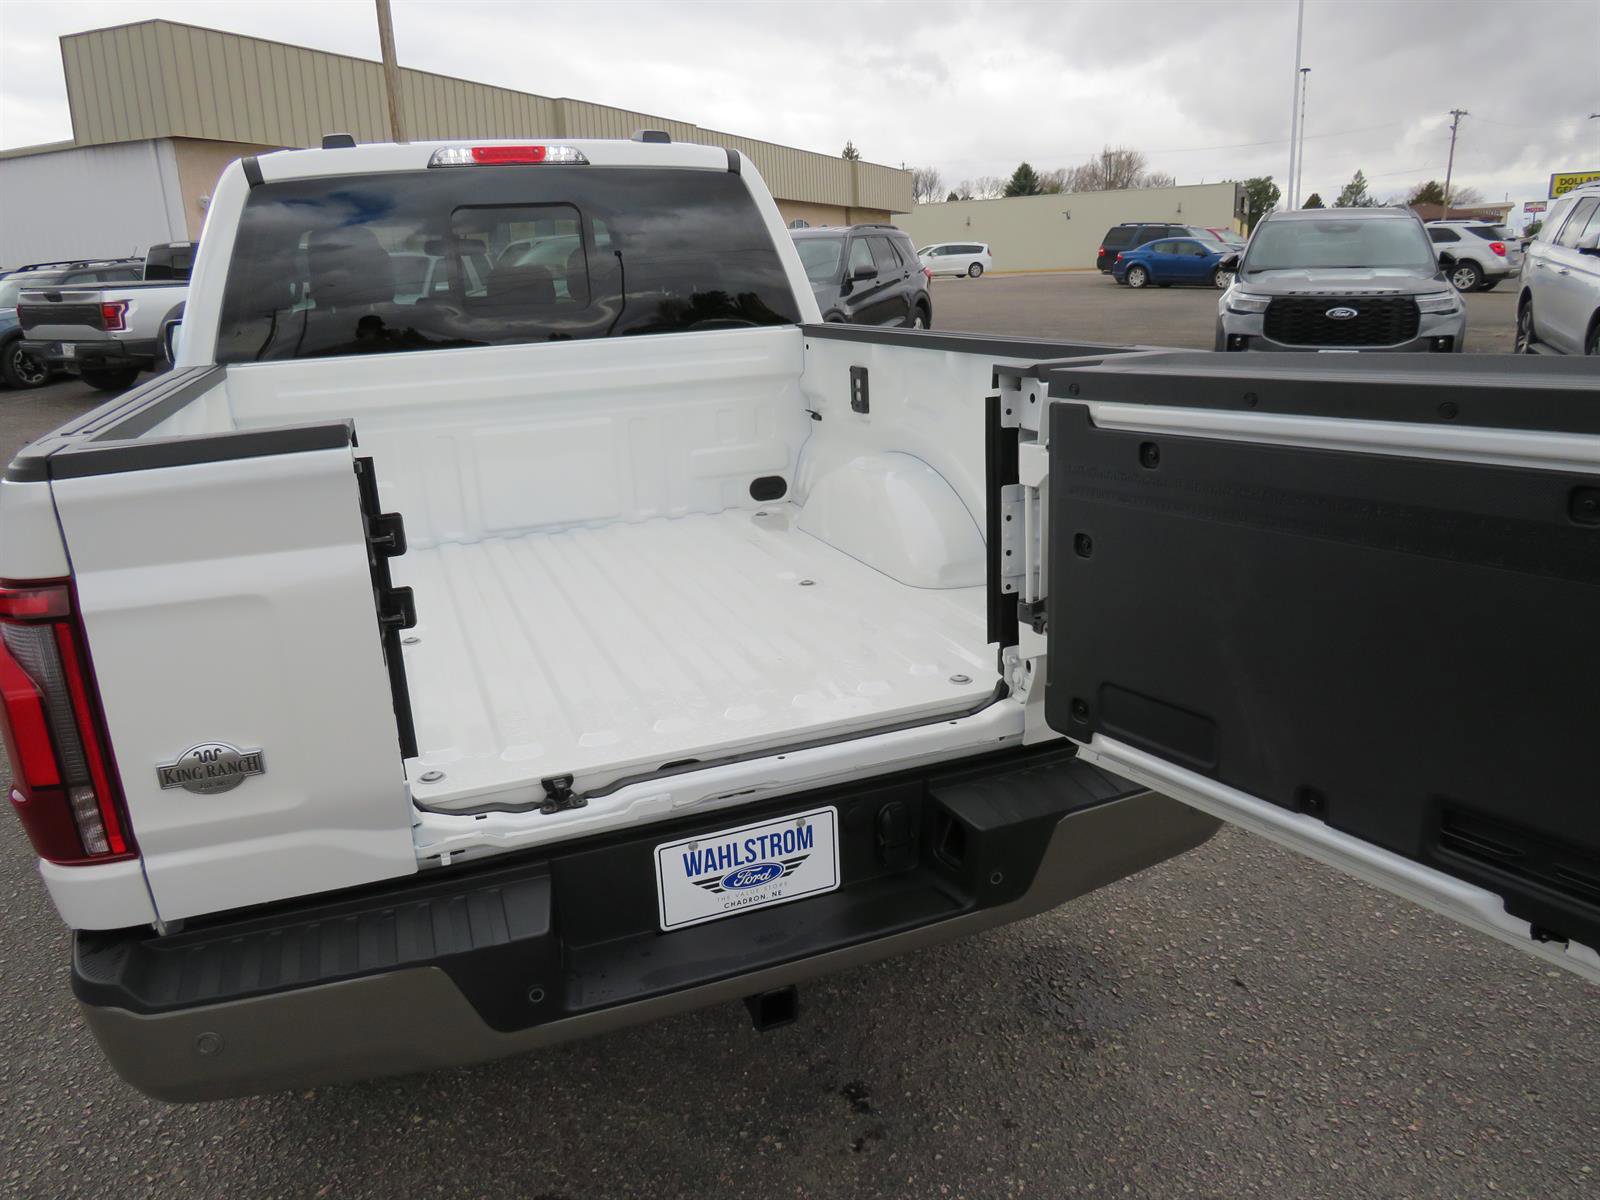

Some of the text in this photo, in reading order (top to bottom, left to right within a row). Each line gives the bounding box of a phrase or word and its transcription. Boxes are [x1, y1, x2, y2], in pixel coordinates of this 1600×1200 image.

[163, 766, 203, 785] KING
[206, 756, 259, 778] RANCH
[682, 824, 813, 878] WAHLSTROM
[734, 866, 772, 887] Ford
[771, 889, 782, 897] NE
